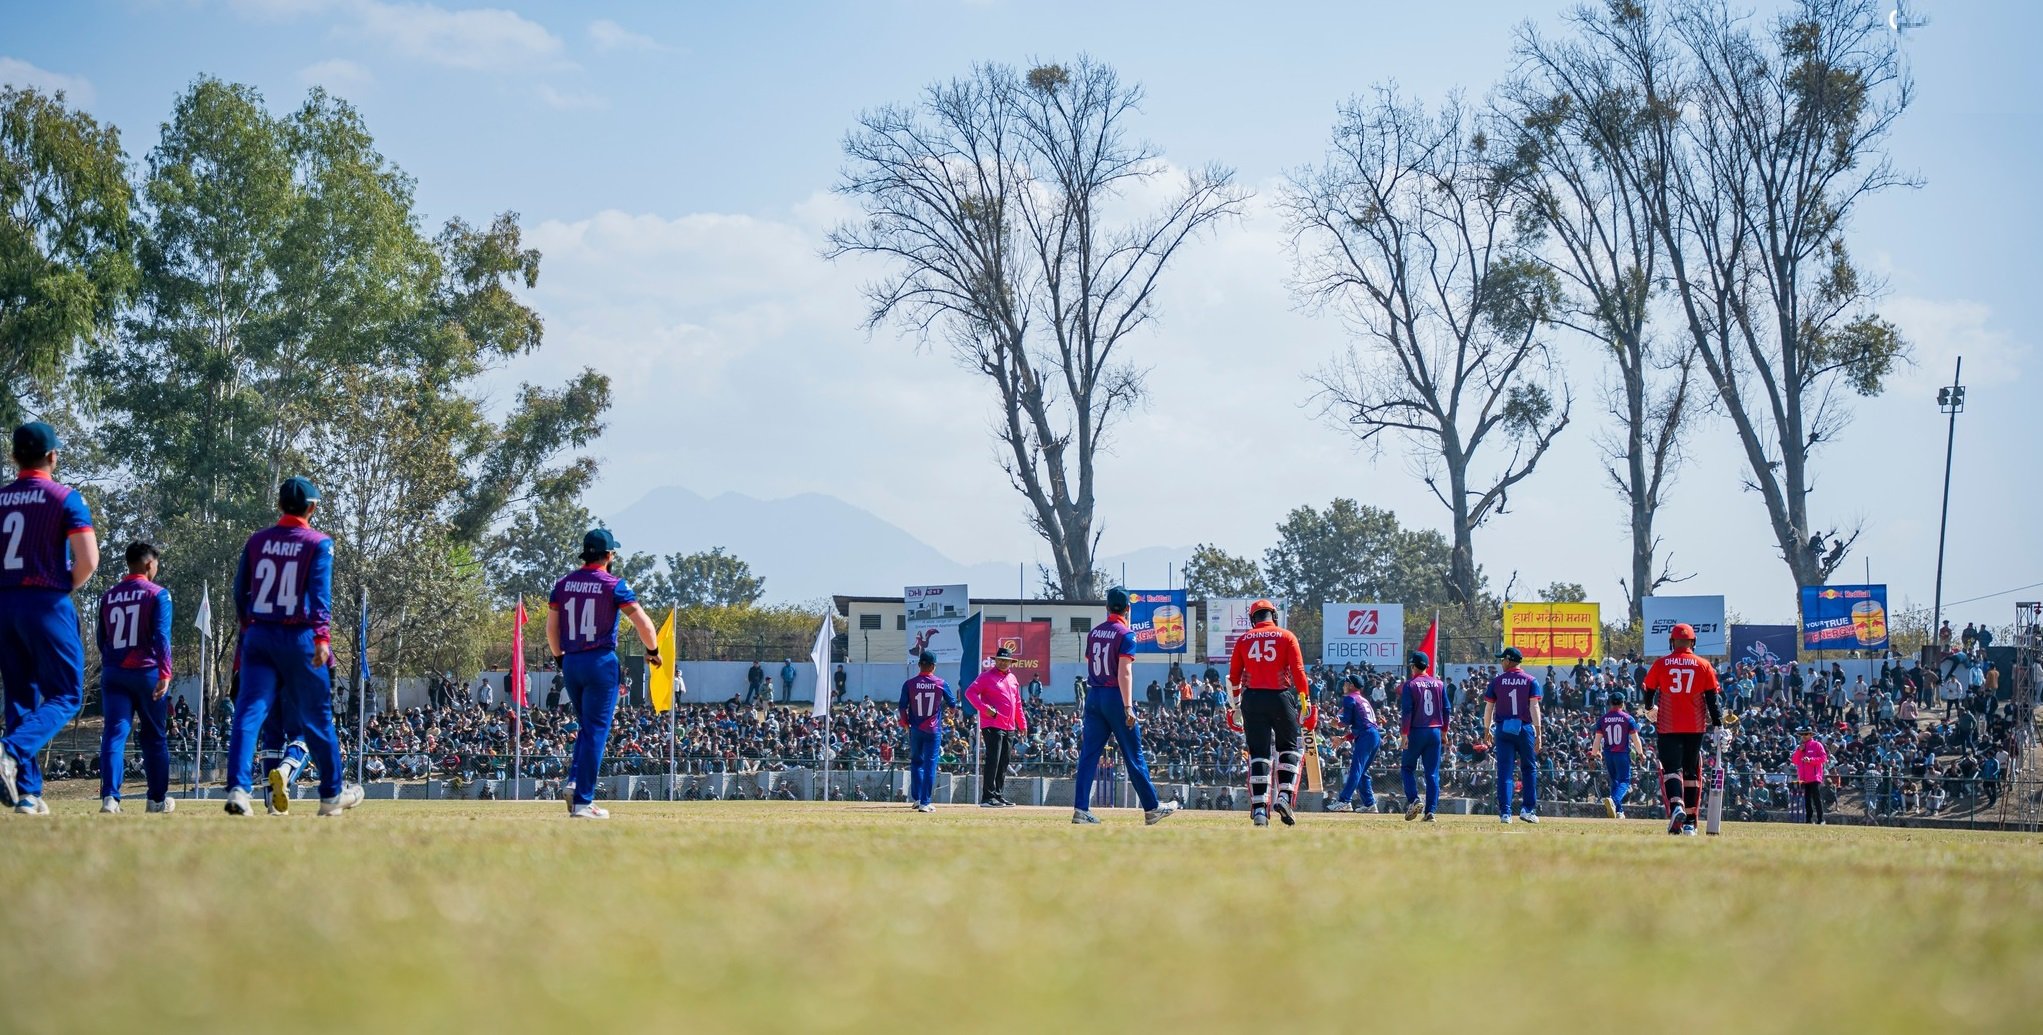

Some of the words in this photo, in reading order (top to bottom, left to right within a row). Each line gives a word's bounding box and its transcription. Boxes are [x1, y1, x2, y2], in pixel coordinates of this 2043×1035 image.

[3, 511, 25, 570] 2
[262, 540, 303, 557] AARIF
[107, 589, 146, 605] LALIT
[253, 559, 298, 616] 24
[564, 581, 603, 594] BHURTEL
[110, 604, 140, 649] 27
[564, 597, 597, 642] 14
[1651, 624, 1700, 634] SPS
[1711, 623, 1718, 632] 1
[1824, 617, 1849, 628] TRUE
[1091, 629, 1117, 640] PAWAN
[1242, 631, 1283, 641] JOHNSON
[1247, 639, 1277, 662] 45
[1327, 642, 1399, 657] FIBERNET
[1092, 642, 1111, 677] 31
[1665, 658, 1699, 667] DHALIWAL
[916, 682, 936, 690] ROHIT
[1501, 678, 1528, 686] RIJAN
[1669, 668, 1695, 694] 37
[915, 692, 935, 717] 17
[1423, 689, 1434, 716] 8
[1508, 689, 1518, 716] 1
[1605, 724, 1622, 746] 10
